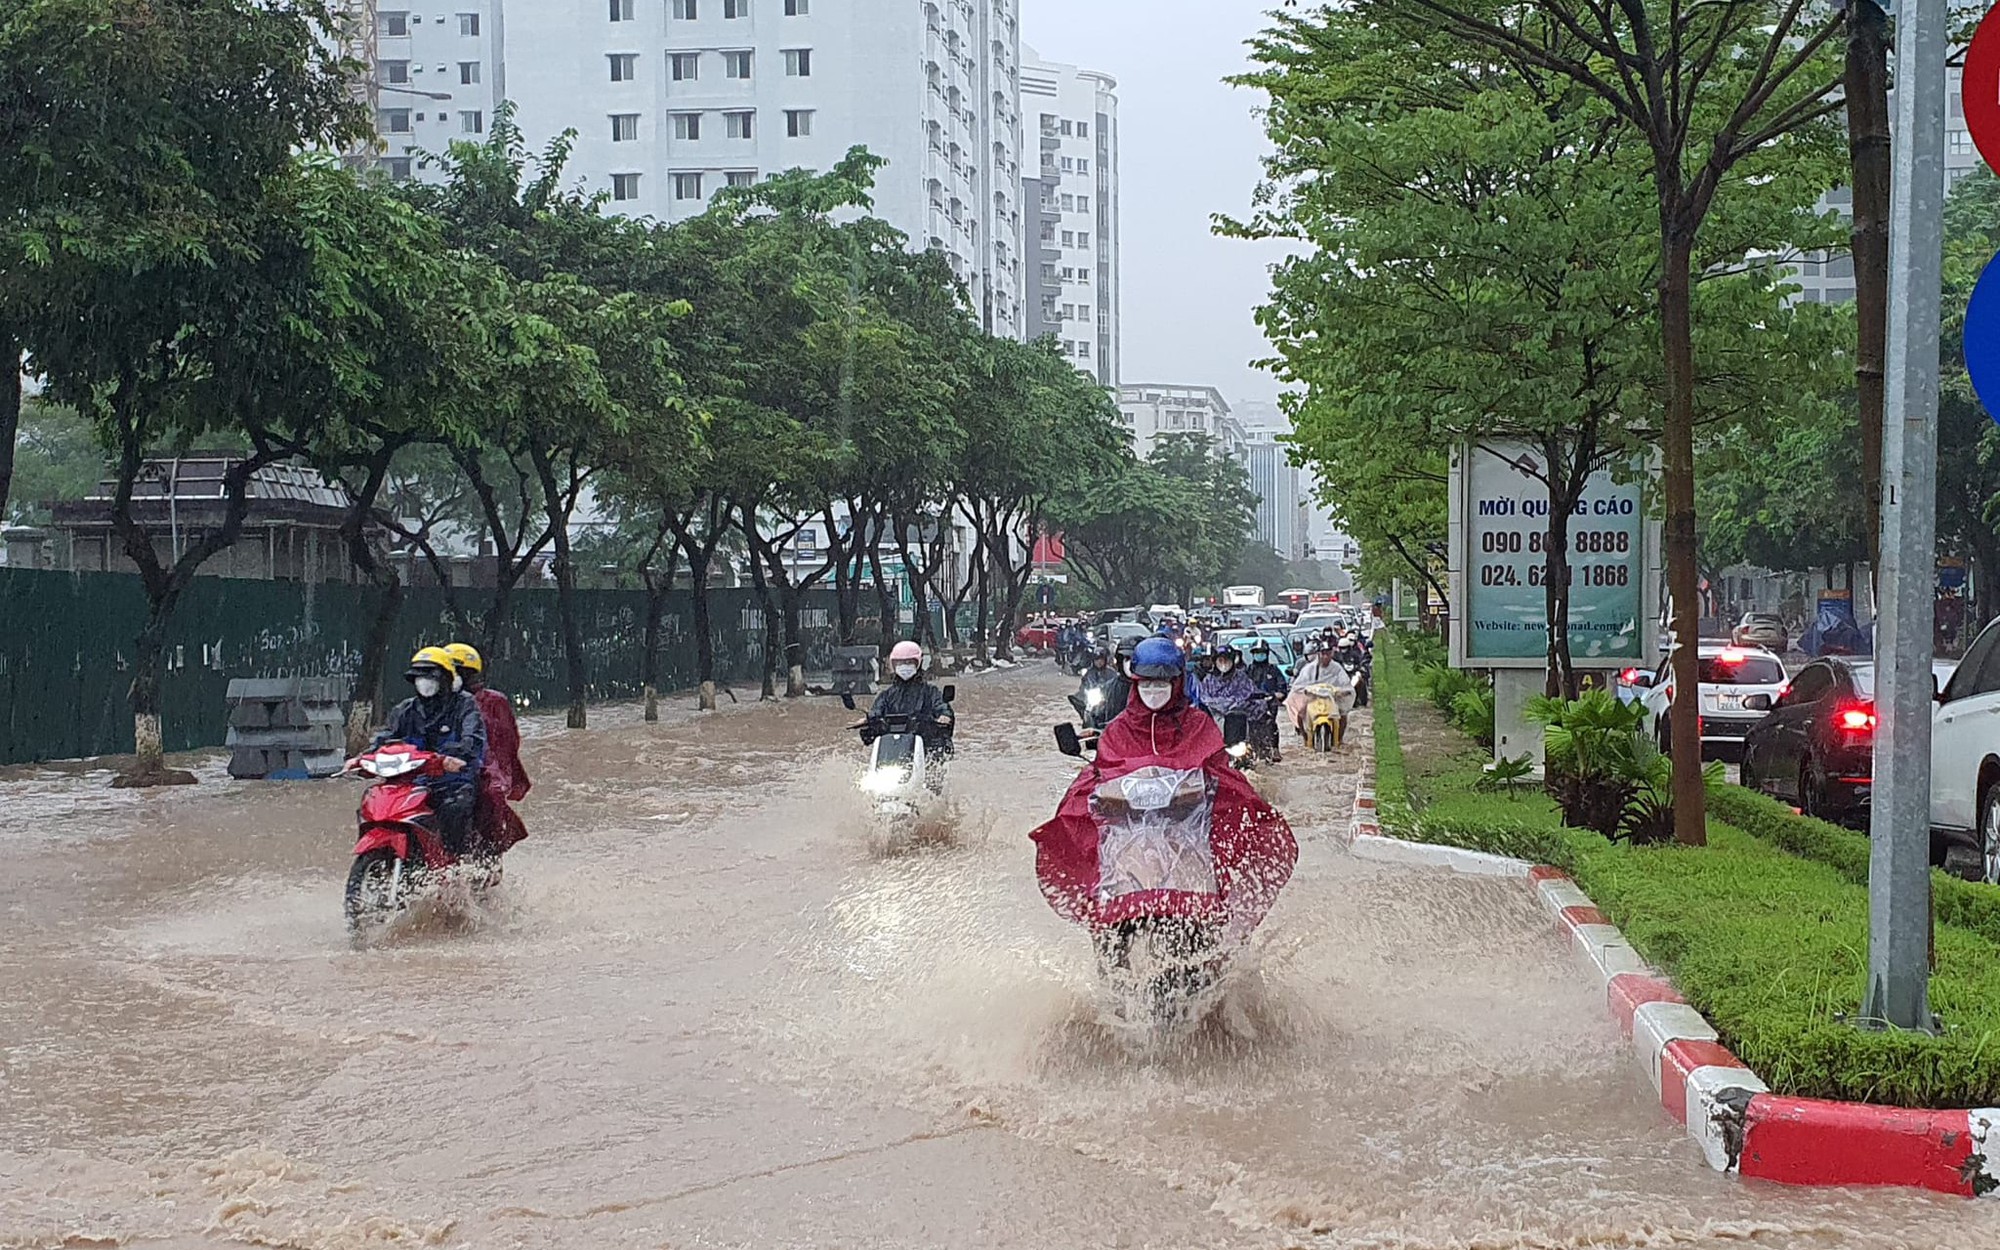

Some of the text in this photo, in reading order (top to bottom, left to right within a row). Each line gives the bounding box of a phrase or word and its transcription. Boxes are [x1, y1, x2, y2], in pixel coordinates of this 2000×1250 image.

[1479, 495, 1633, 518] MỜI QUG CÁO
[1482, 531, 1521, 553] 090
[1576, 531, 1629, 553] 8888
[1481, 565, 1521, 586] 024.
[1582, 565, 1628, 586] 1868
[1475, 621, 1520, 631] Website:
